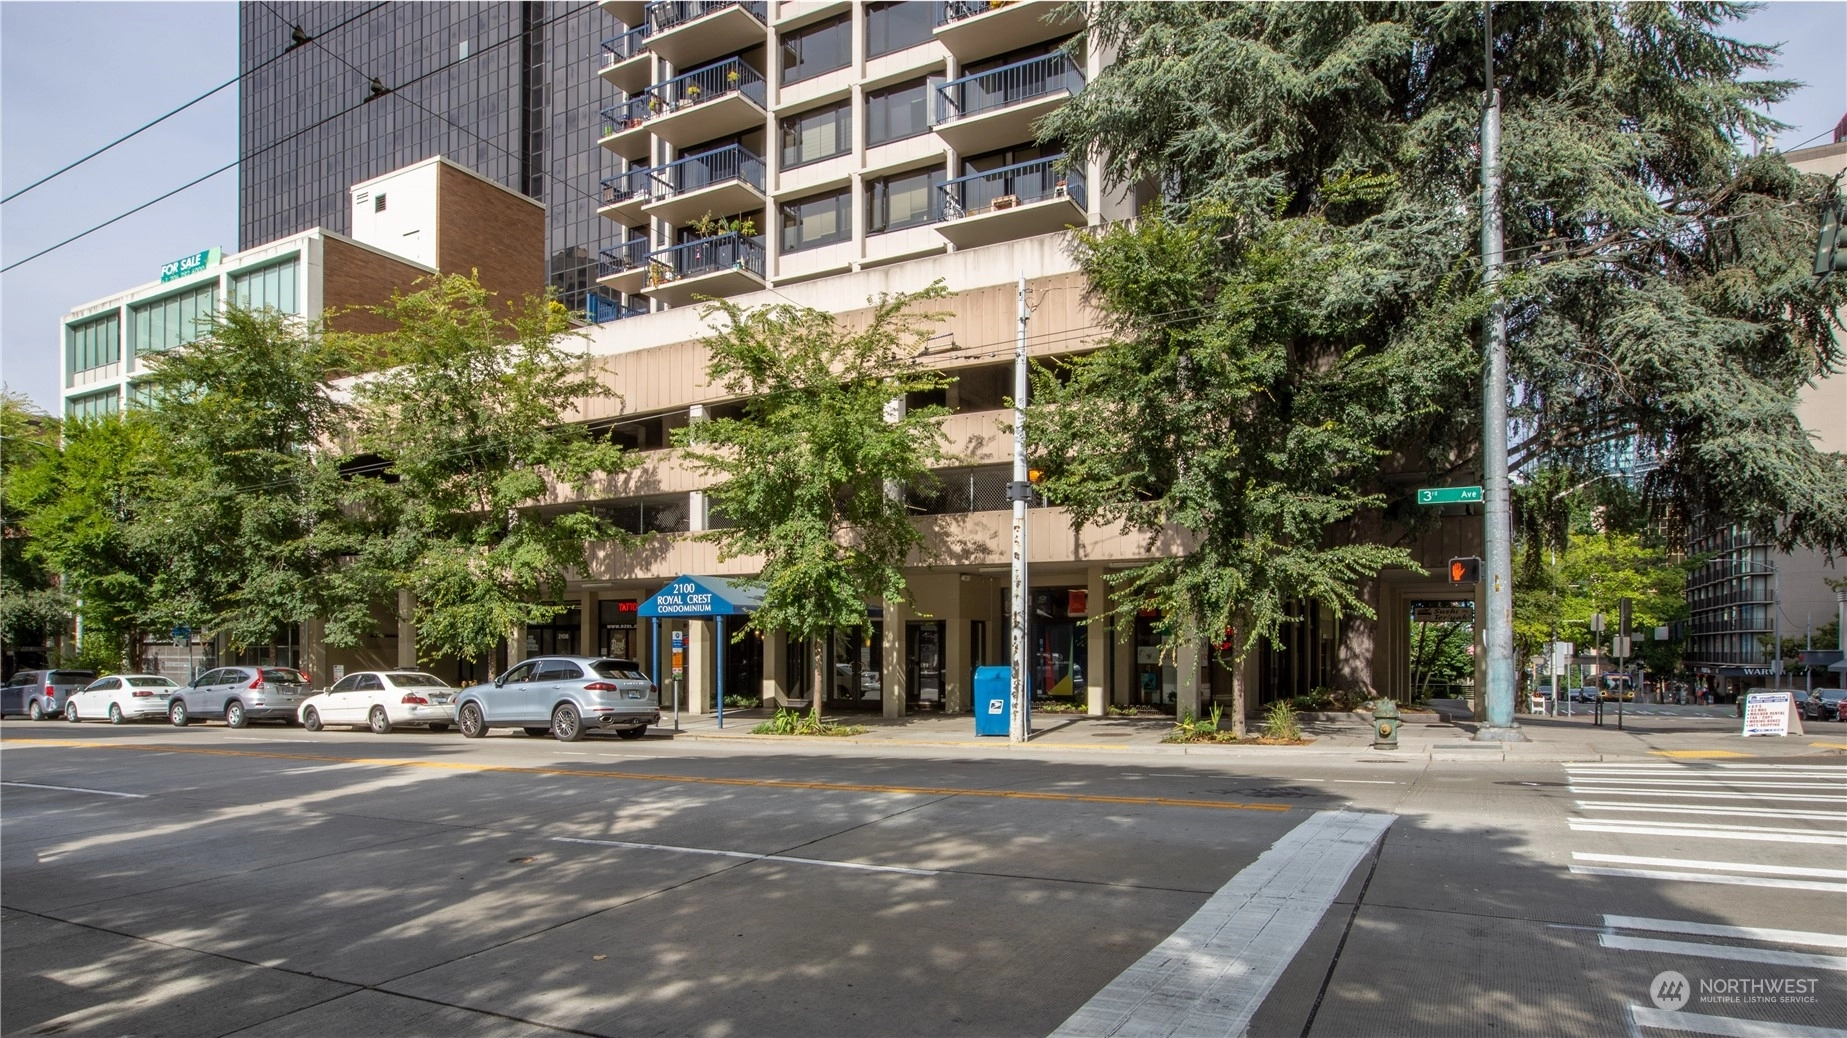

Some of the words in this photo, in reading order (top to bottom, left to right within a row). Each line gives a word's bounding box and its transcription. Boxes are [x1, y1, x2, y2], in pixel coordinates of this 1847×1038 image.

[161, 262, 179, 277] FOR
[180, 254, 202, 271] SALE
[1423, 491, 1438, 501] 3rd
[673, 583, 695, 594] 2100
[657, 595, 683, 605] ROYAL
[686, 593, 712, 604] CREST
[657, 604, 712, 613] CONDOMINIUM
